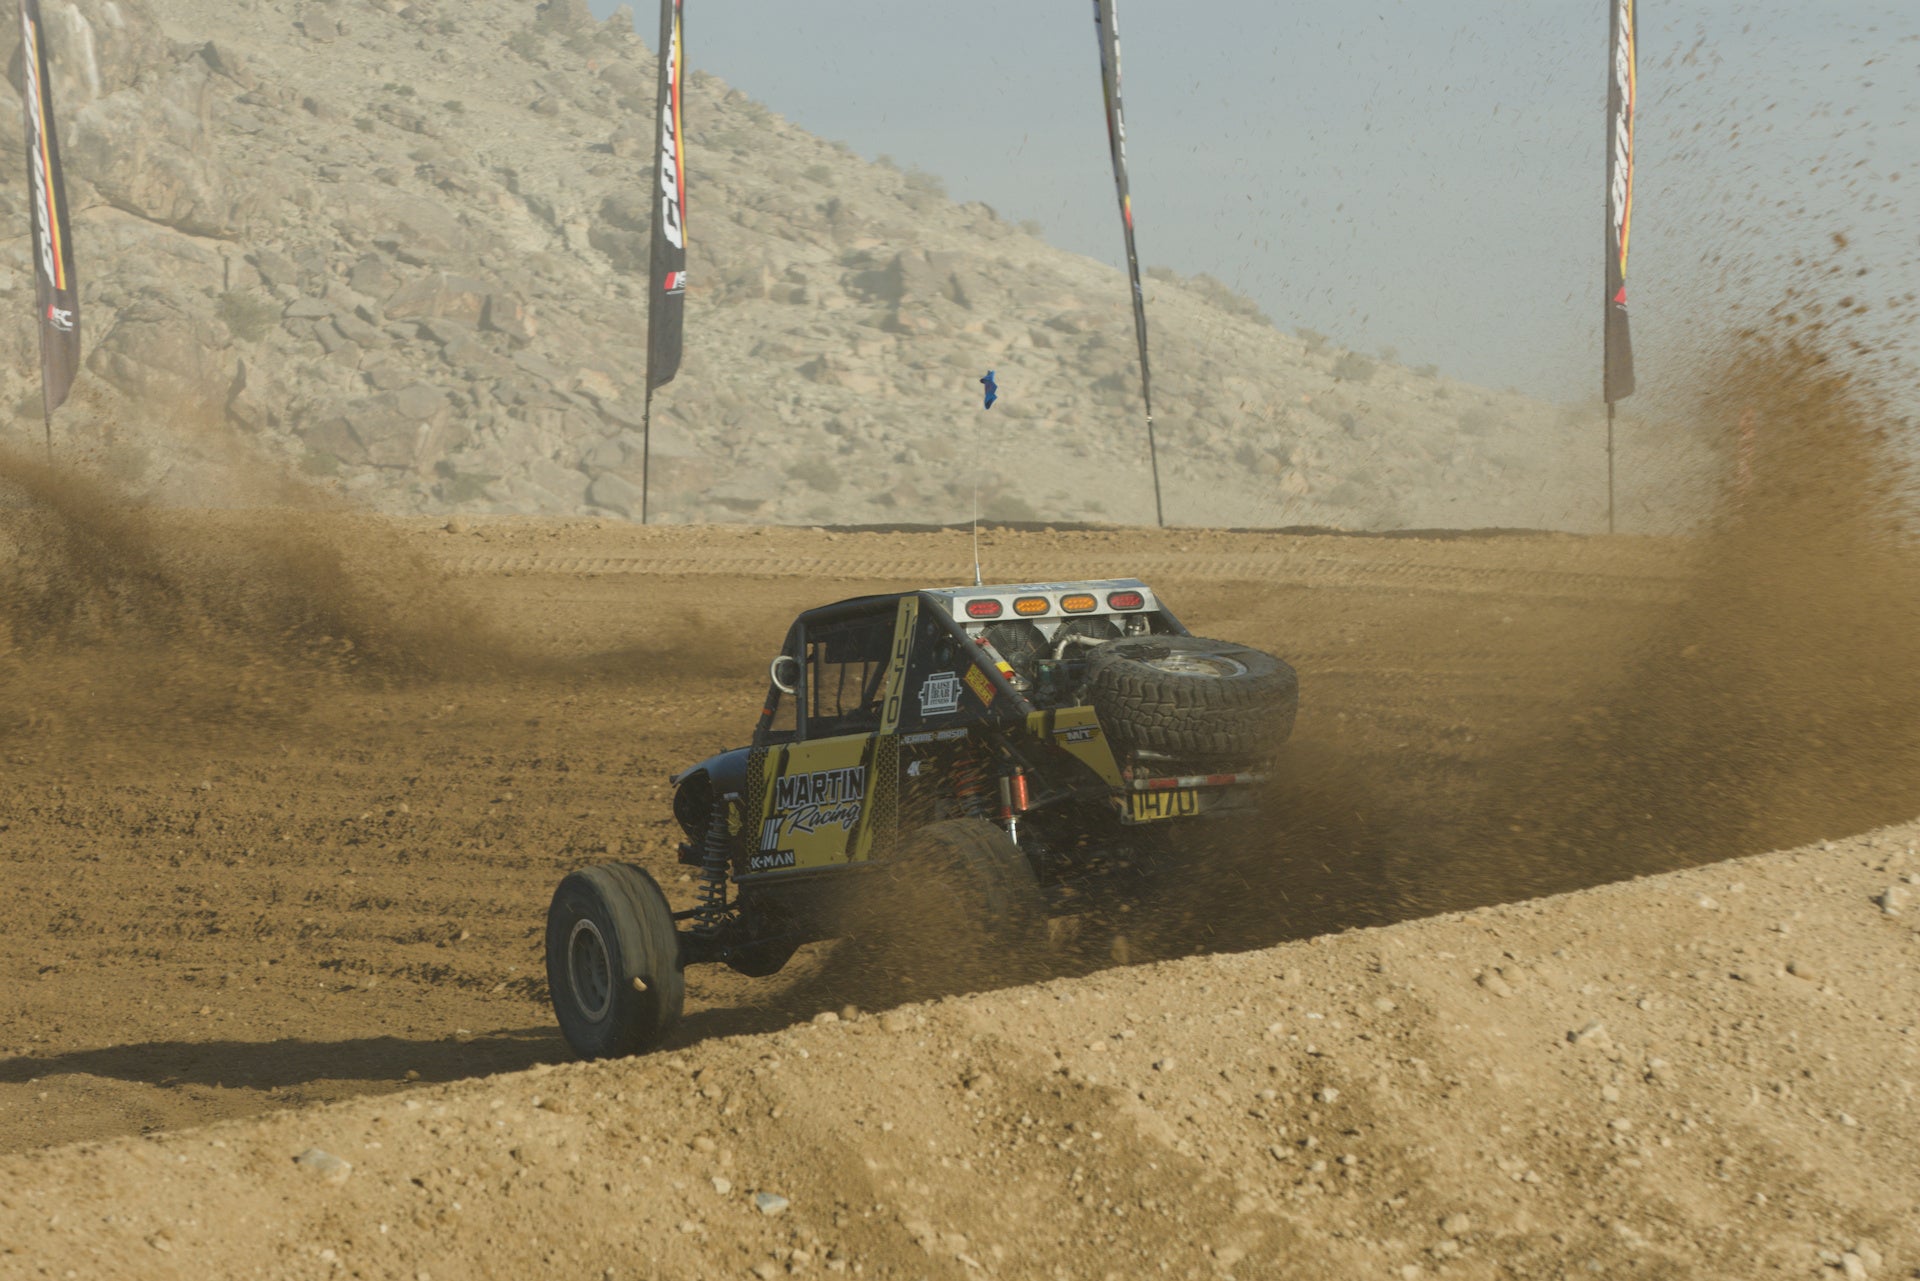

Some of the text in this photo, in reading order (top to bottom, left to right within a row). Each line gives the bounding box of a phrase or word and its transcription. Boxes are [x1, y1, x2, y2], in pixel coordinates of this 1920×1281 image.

[887, 610, 910, 723] 1470
[935, 688, 950, 698] BAR
[776, 766, 865, 810] MARTIN
[1139, 790, 1195, 818] 1470
[787, 803, 861, 836] Racing
